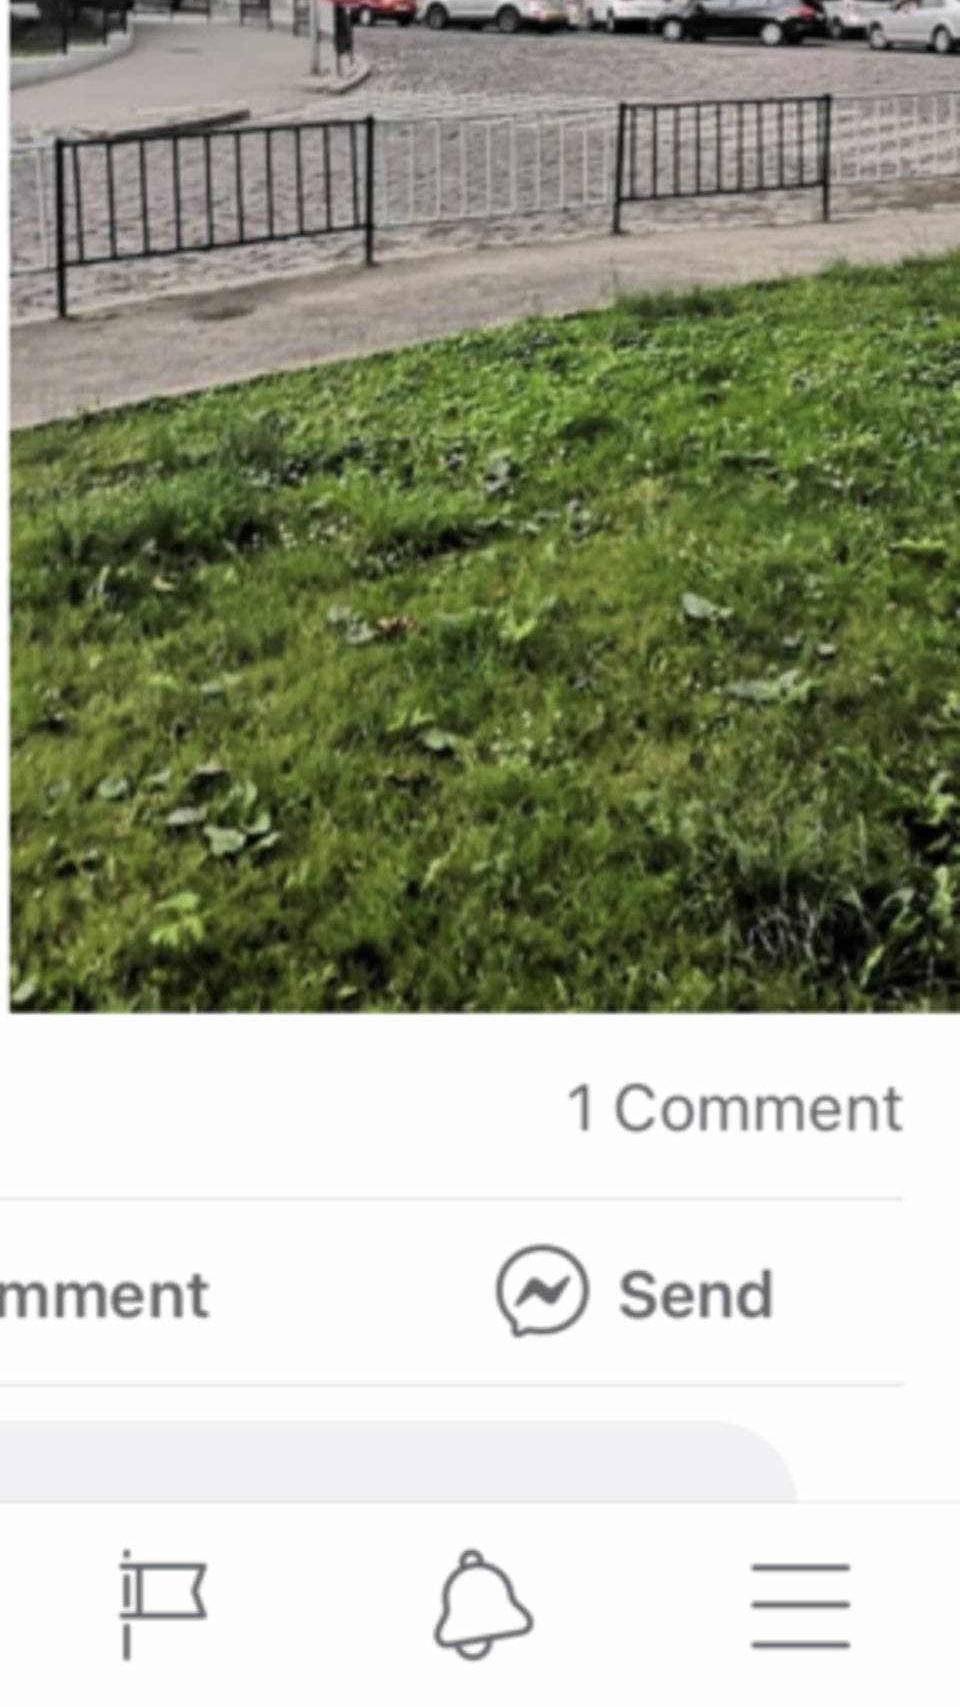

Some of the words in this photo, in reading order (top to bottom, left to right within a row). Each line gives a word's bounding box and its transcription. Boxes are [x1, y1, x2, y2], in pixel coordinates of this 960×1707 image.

[568, 1082, 590, 1133] 1
[614, 1081, 904, 1134] Comment
[619, 1267, 773, 1321] Send
